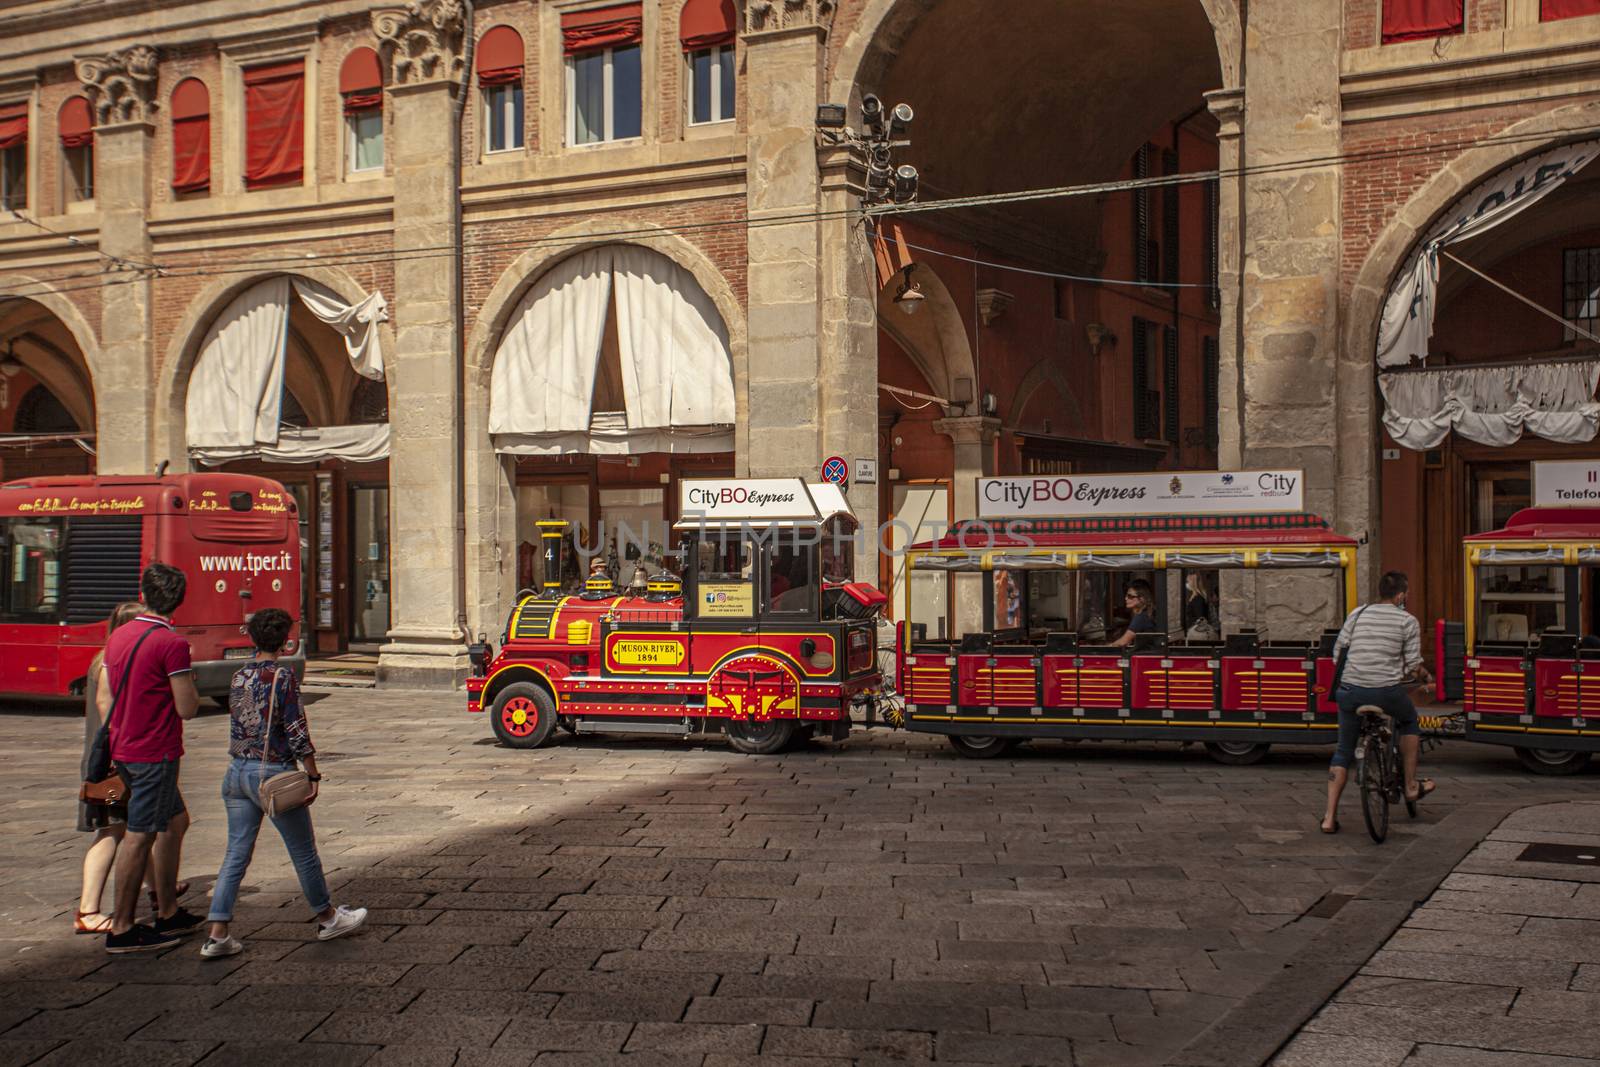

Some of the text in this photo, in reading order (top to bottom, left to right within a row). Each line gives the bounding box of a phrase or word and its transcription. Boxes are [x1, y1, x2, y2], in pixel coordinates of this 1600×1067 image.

[1258, 473, 1296, 495] City
[1555, 489, 1600, 499] Telefo
[545, 548, 552, 560] 4
[200, 551, 292, 576] www.tper.it
